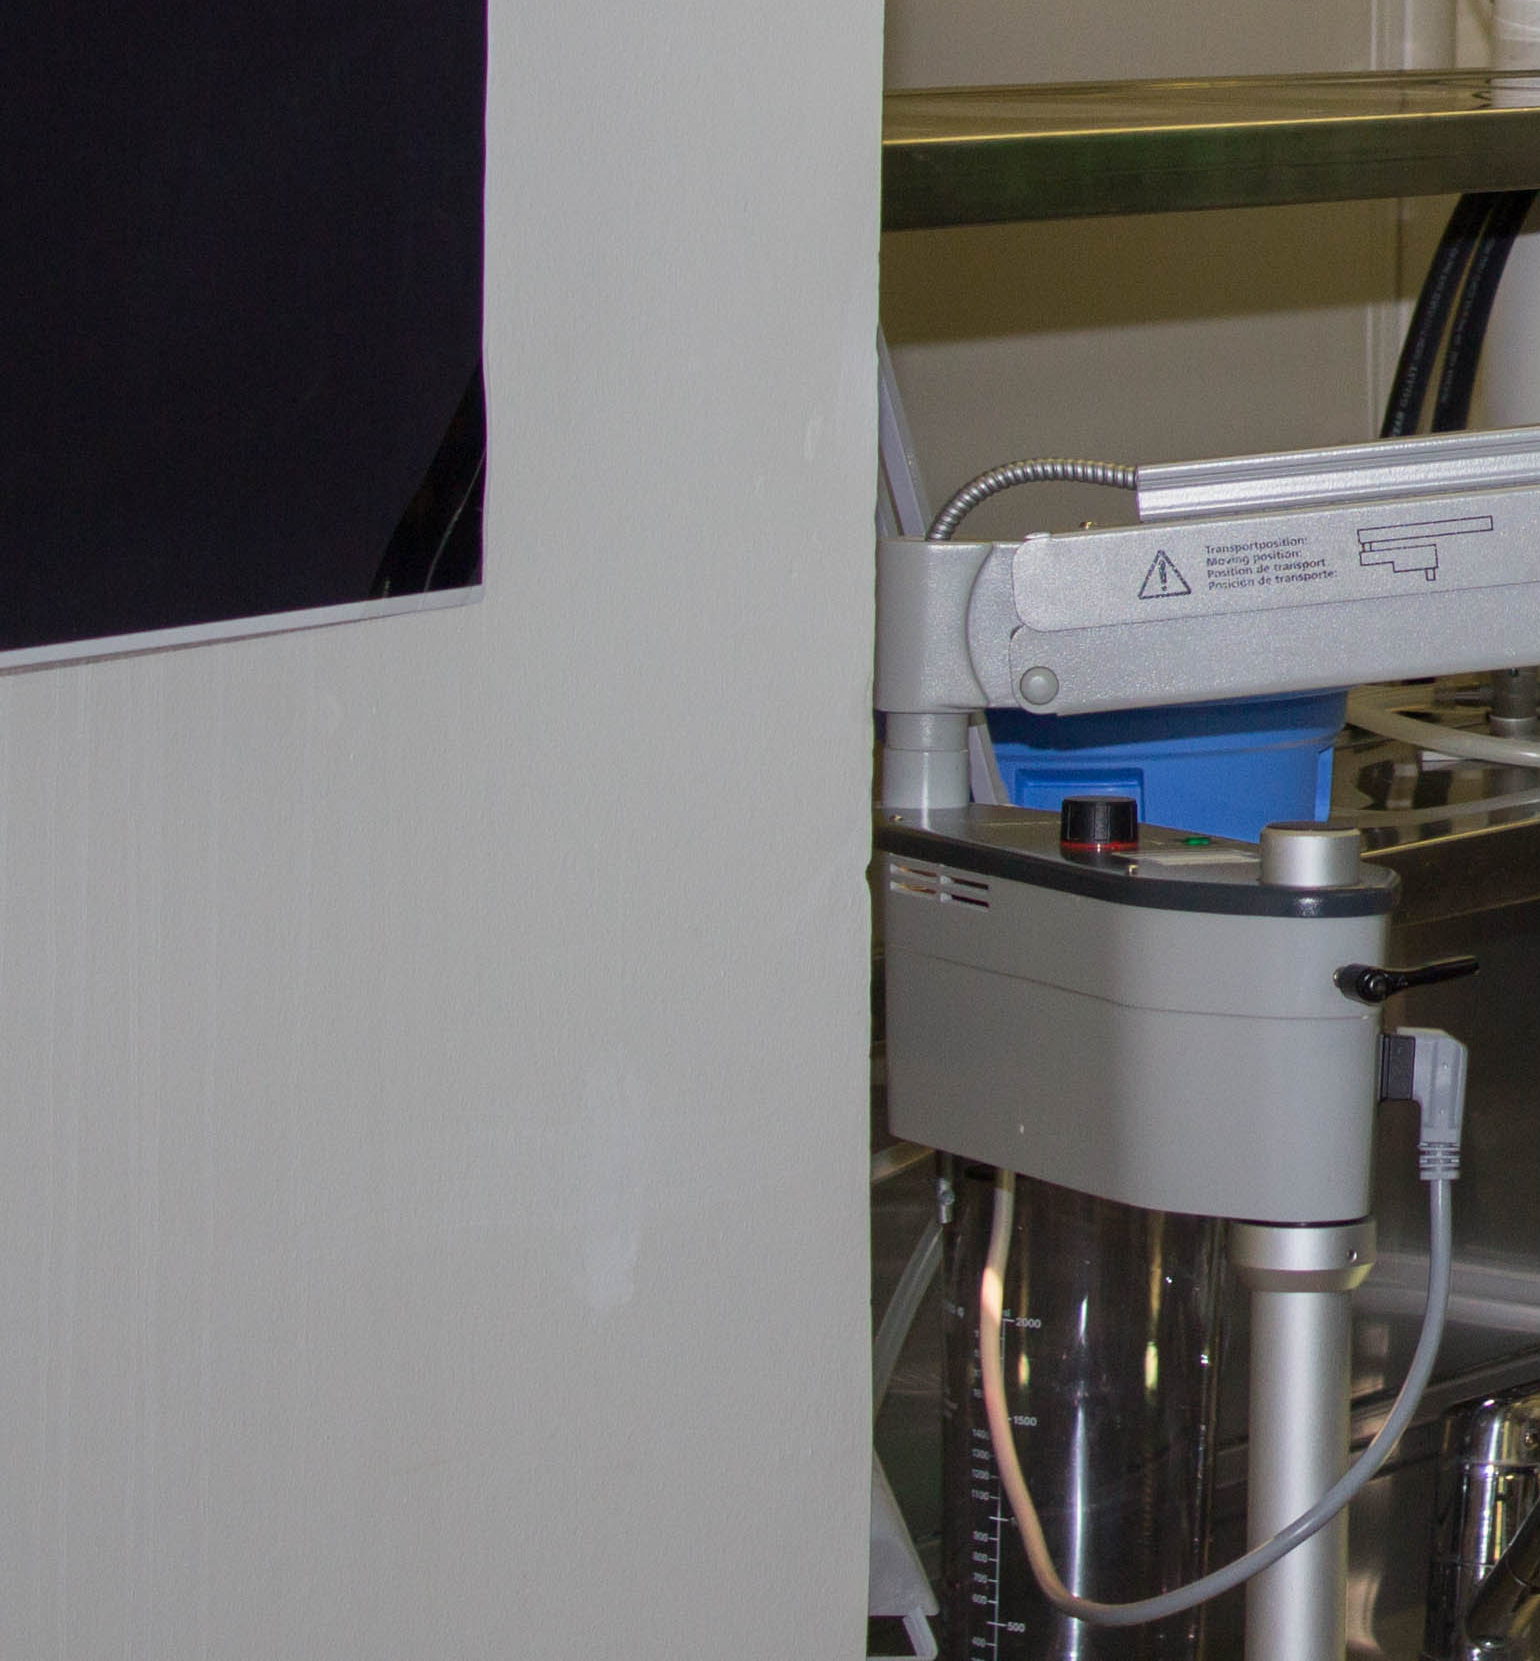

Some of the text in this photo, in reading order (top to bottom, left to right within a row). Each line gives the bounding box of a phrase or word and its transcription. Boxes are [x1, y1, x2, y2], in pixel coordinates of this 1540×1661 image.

[1015, 1317, 1041, 1329] 2000
[1013, 1416, 1037, 1427] 1500
[1007, 1622, 1026, 1633] 500
